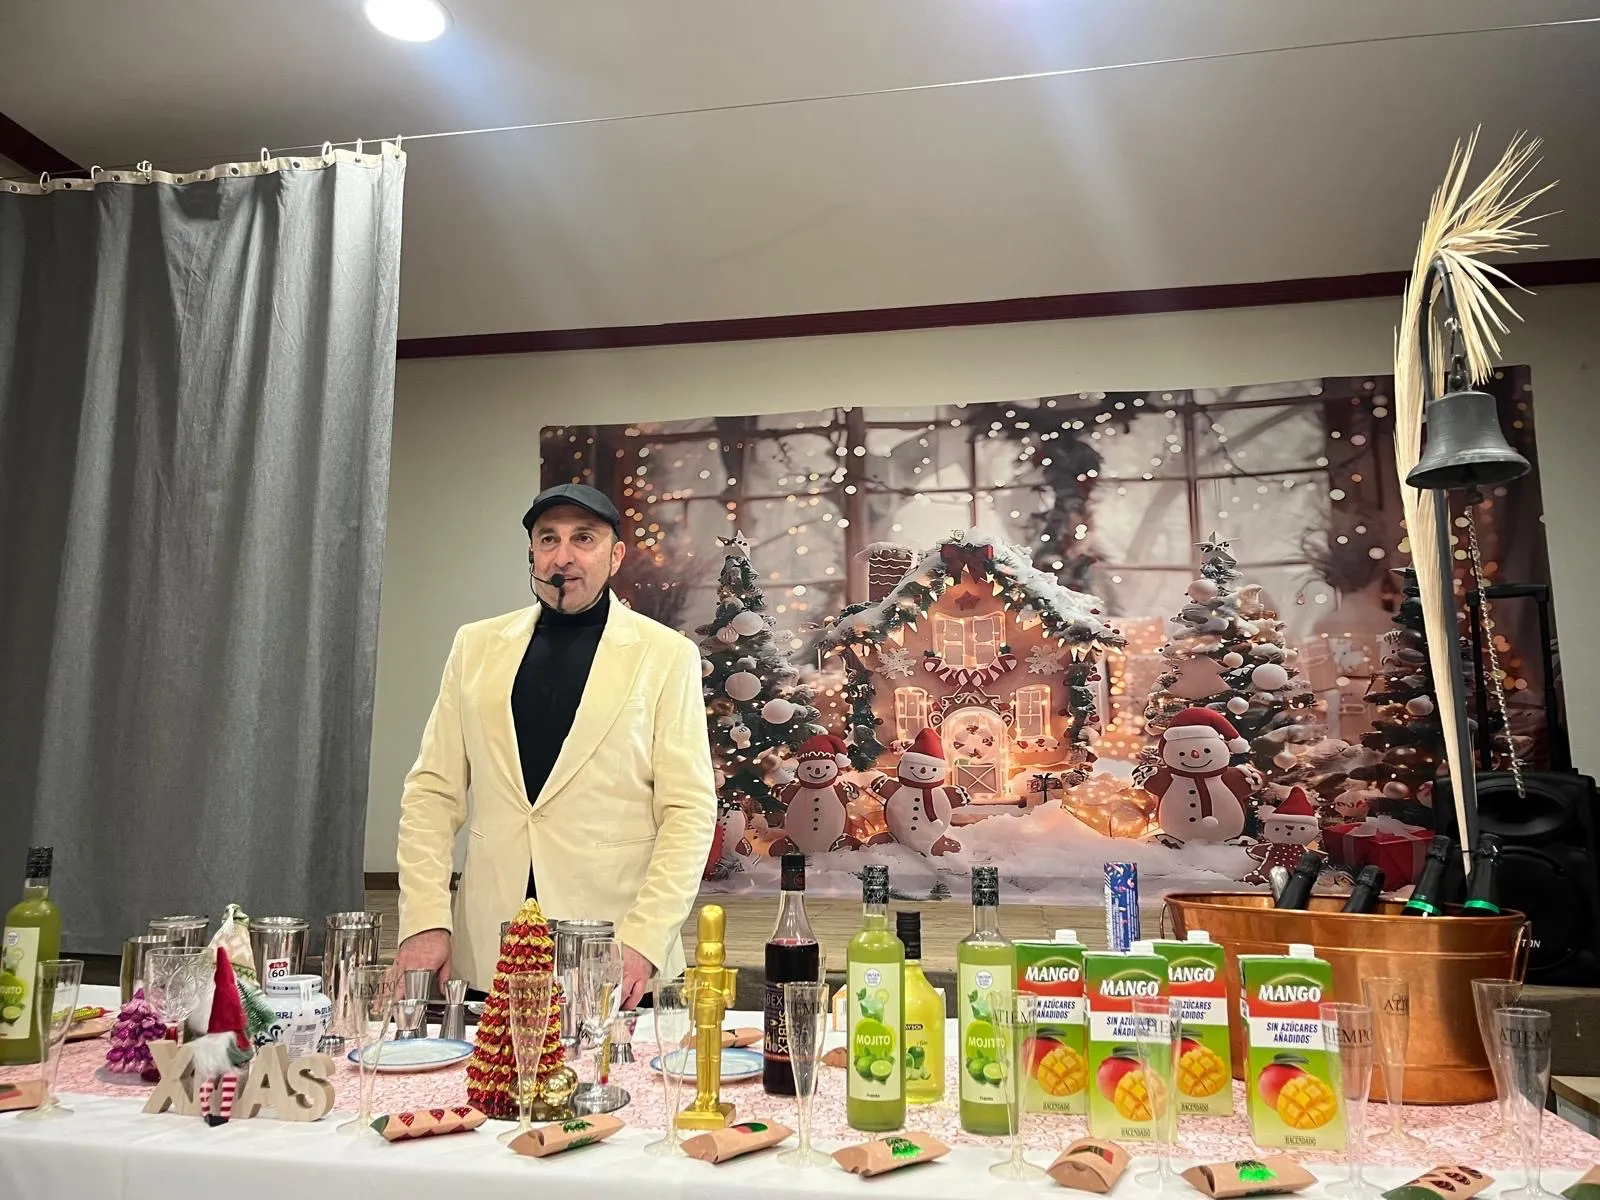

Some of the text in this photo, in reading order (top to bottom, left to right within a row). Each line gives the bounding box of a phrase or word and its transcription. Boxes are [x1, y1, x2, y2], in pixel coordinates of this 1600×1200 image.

[271, 969, 285, 978] 60
[1025, 966, 1080, 983] MANGO
[1099, 979, 1160, 997] MANGO
[1258, 984, 1321, 1003] MANGO
[1043, 998, 1076, 1009] AZÚCARES
[1107, 1016, 1118, 1025] SIN
[1267, 1020, 1318, 1034] SIN AZÚCARES
[856, 1034, 891, 1046] MOJITO
[968, 1036, 1006, 1049] MOJITO
